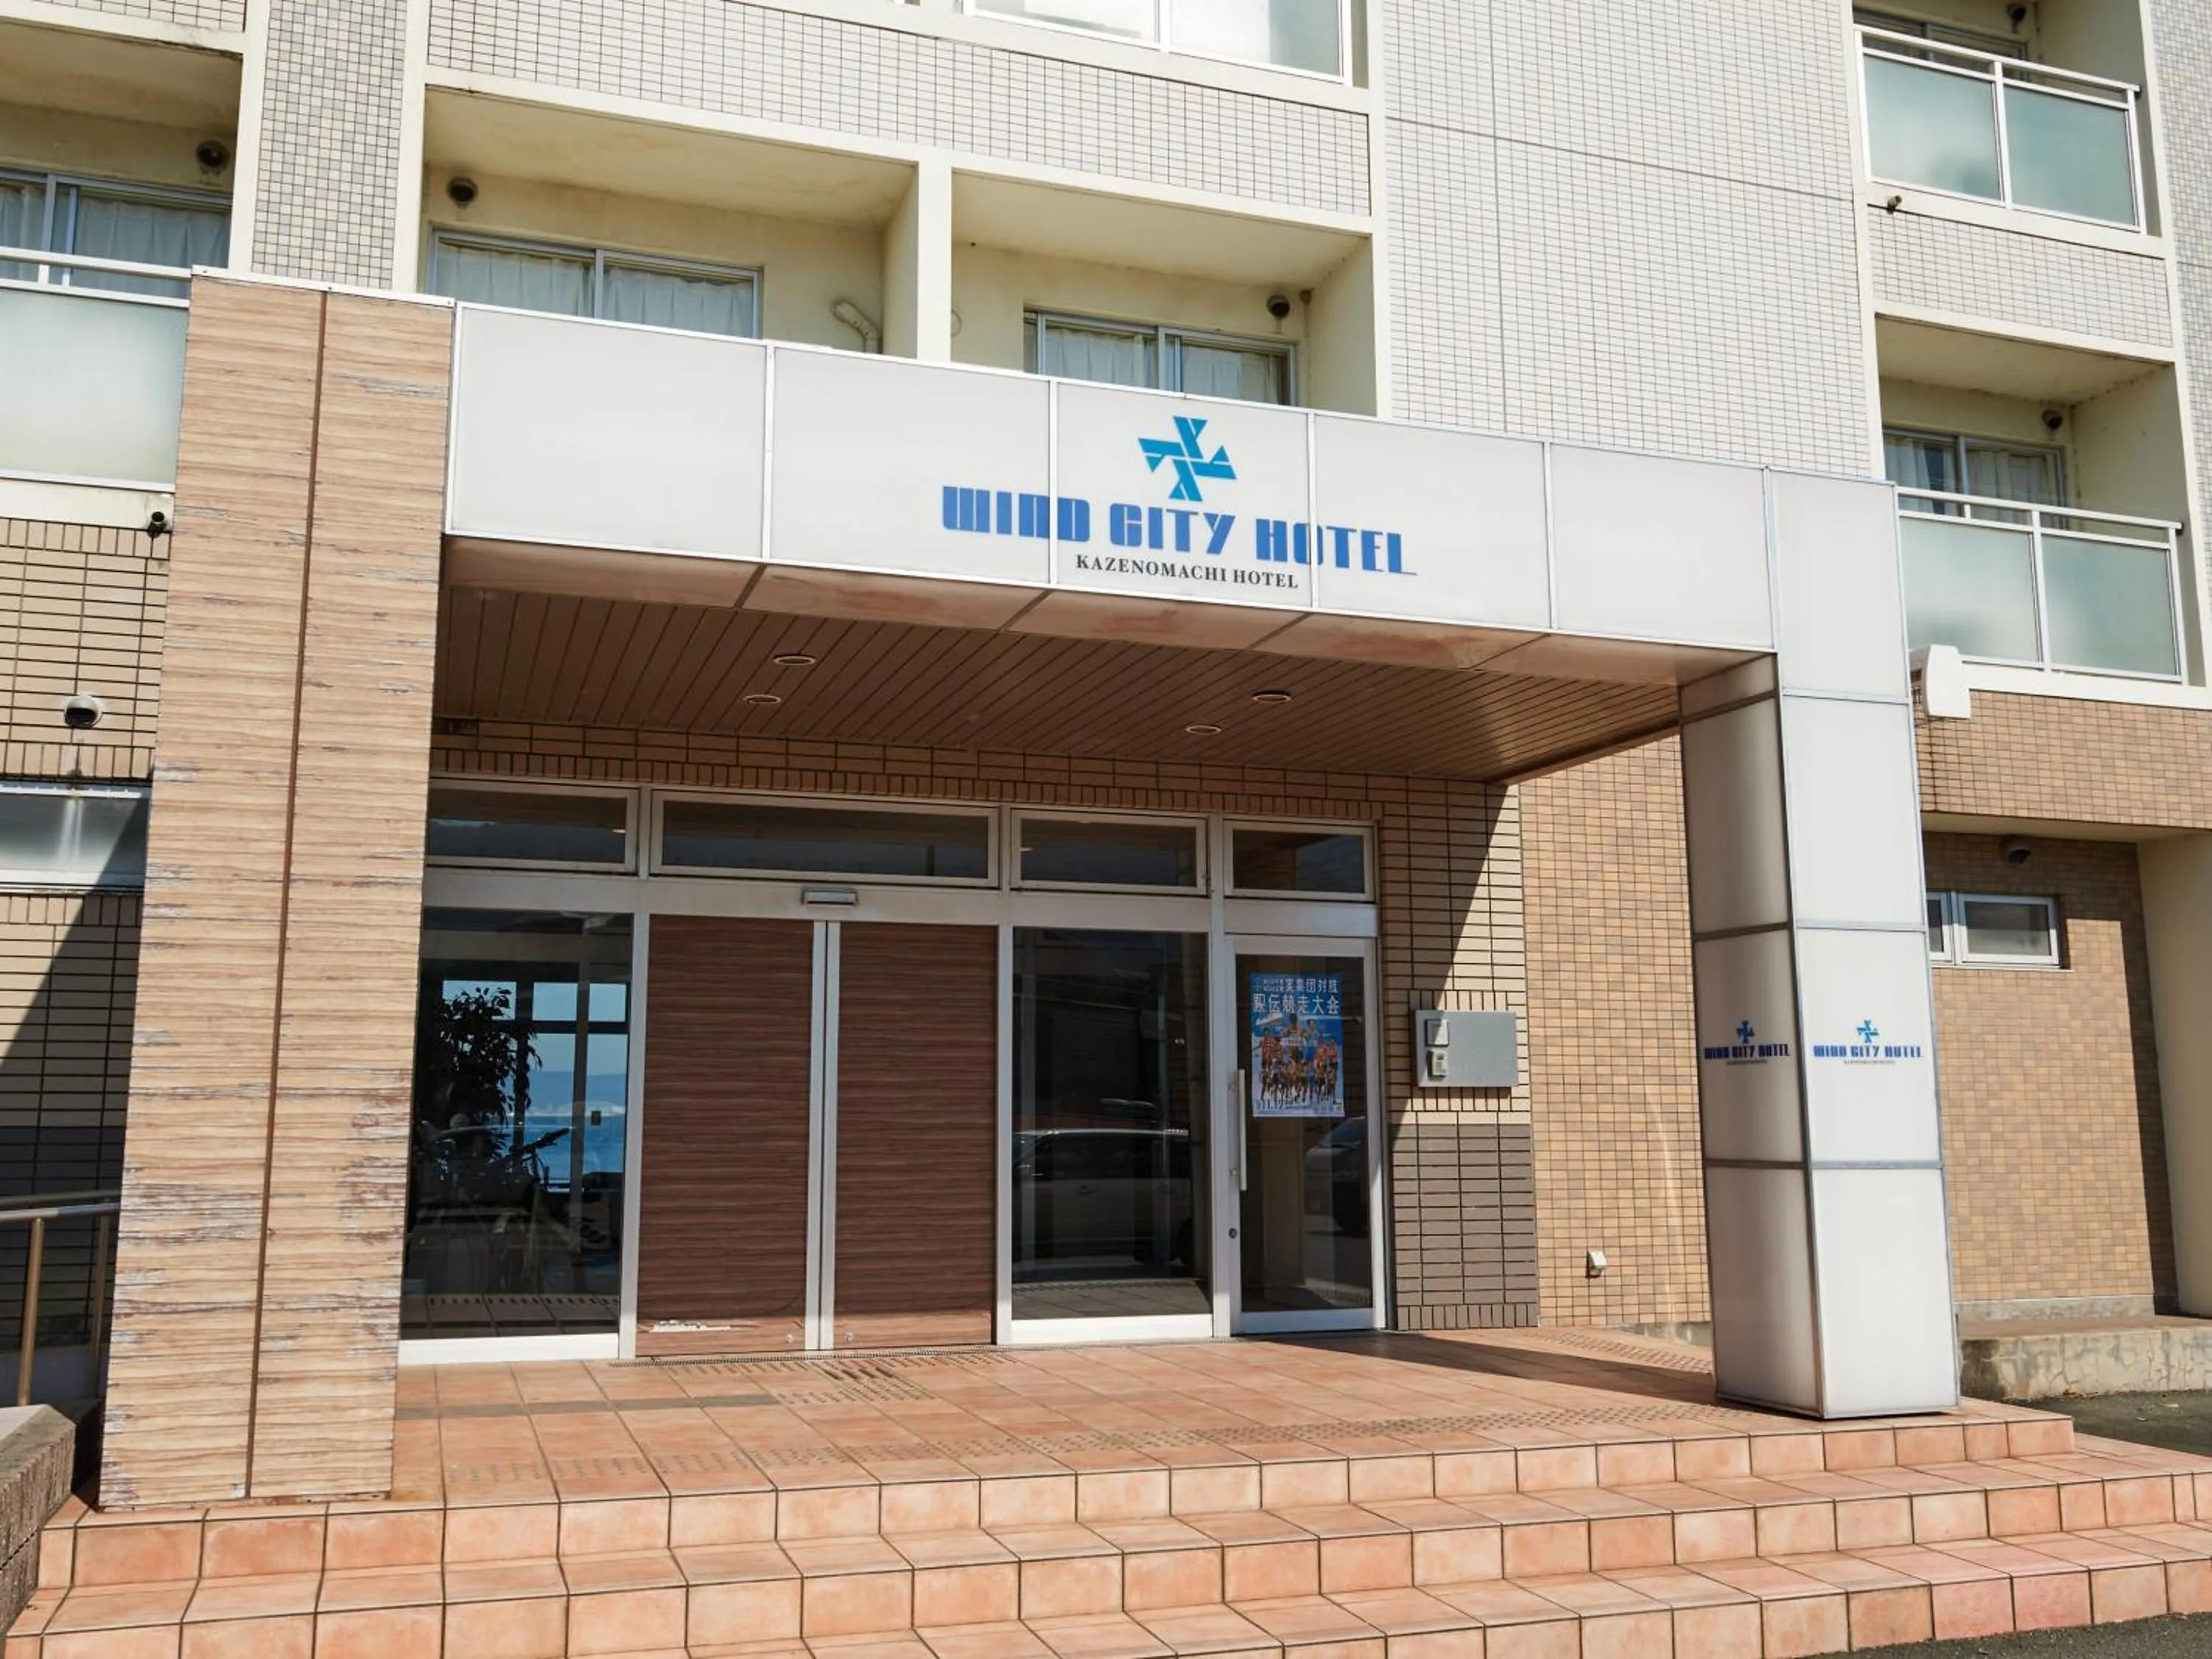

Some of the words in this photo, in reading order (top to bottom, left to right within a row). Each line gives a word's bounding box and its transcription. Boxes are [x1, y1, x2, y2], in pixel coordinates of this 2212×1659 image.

[943, 485, 1090, 543] WIND
[1110, 502, 1235, 554] CITY
[1256, 518, 1417, 576] HOTEL
[1076, 554, 1227, 582] KAZENOMACHI
[1233, 569, 1298, 588] HOTEL
[1850, 1045, 1880, 1058] CITY
[1884, 1046, 1923, 1058] HOTEL
